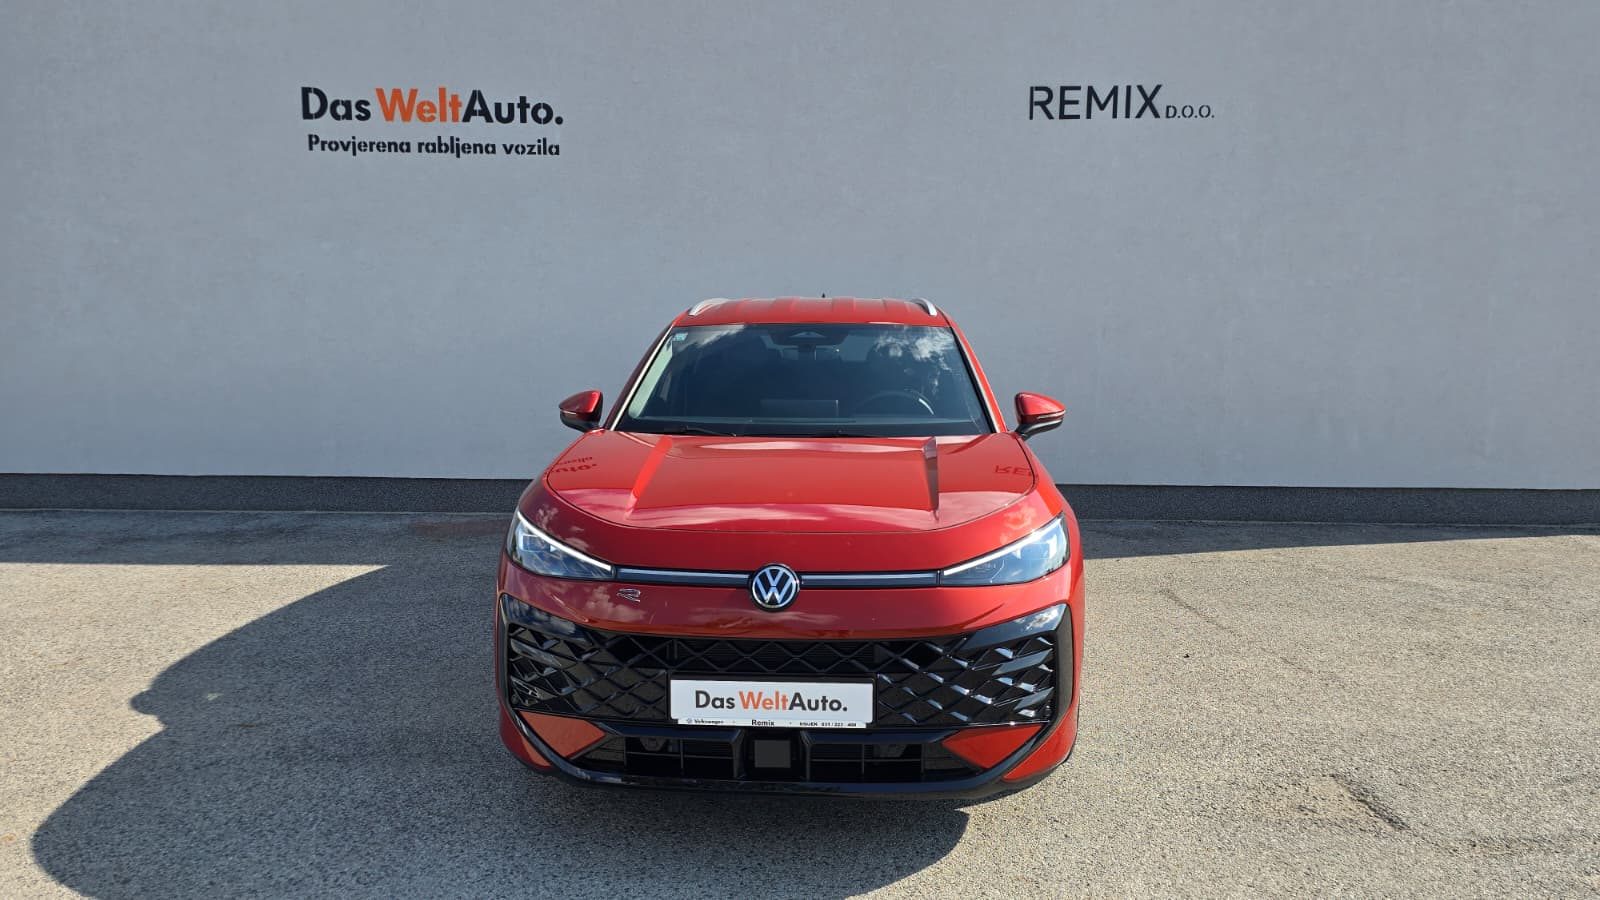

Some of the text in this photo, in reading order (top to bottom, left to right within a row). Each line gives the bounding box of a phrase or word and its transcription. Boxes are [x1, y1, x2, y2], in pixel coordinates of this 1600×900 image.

[301, 86, 564, 125] Das WeltAuto.
[1029, 85, 1216, 120] REMIX D.O.O.
[307, 134, 561, 159] Provjerena rabljena vozila
[694, 690, 848, 712] Das WeltAuto.
[751, 719, 775, 727] Remix
